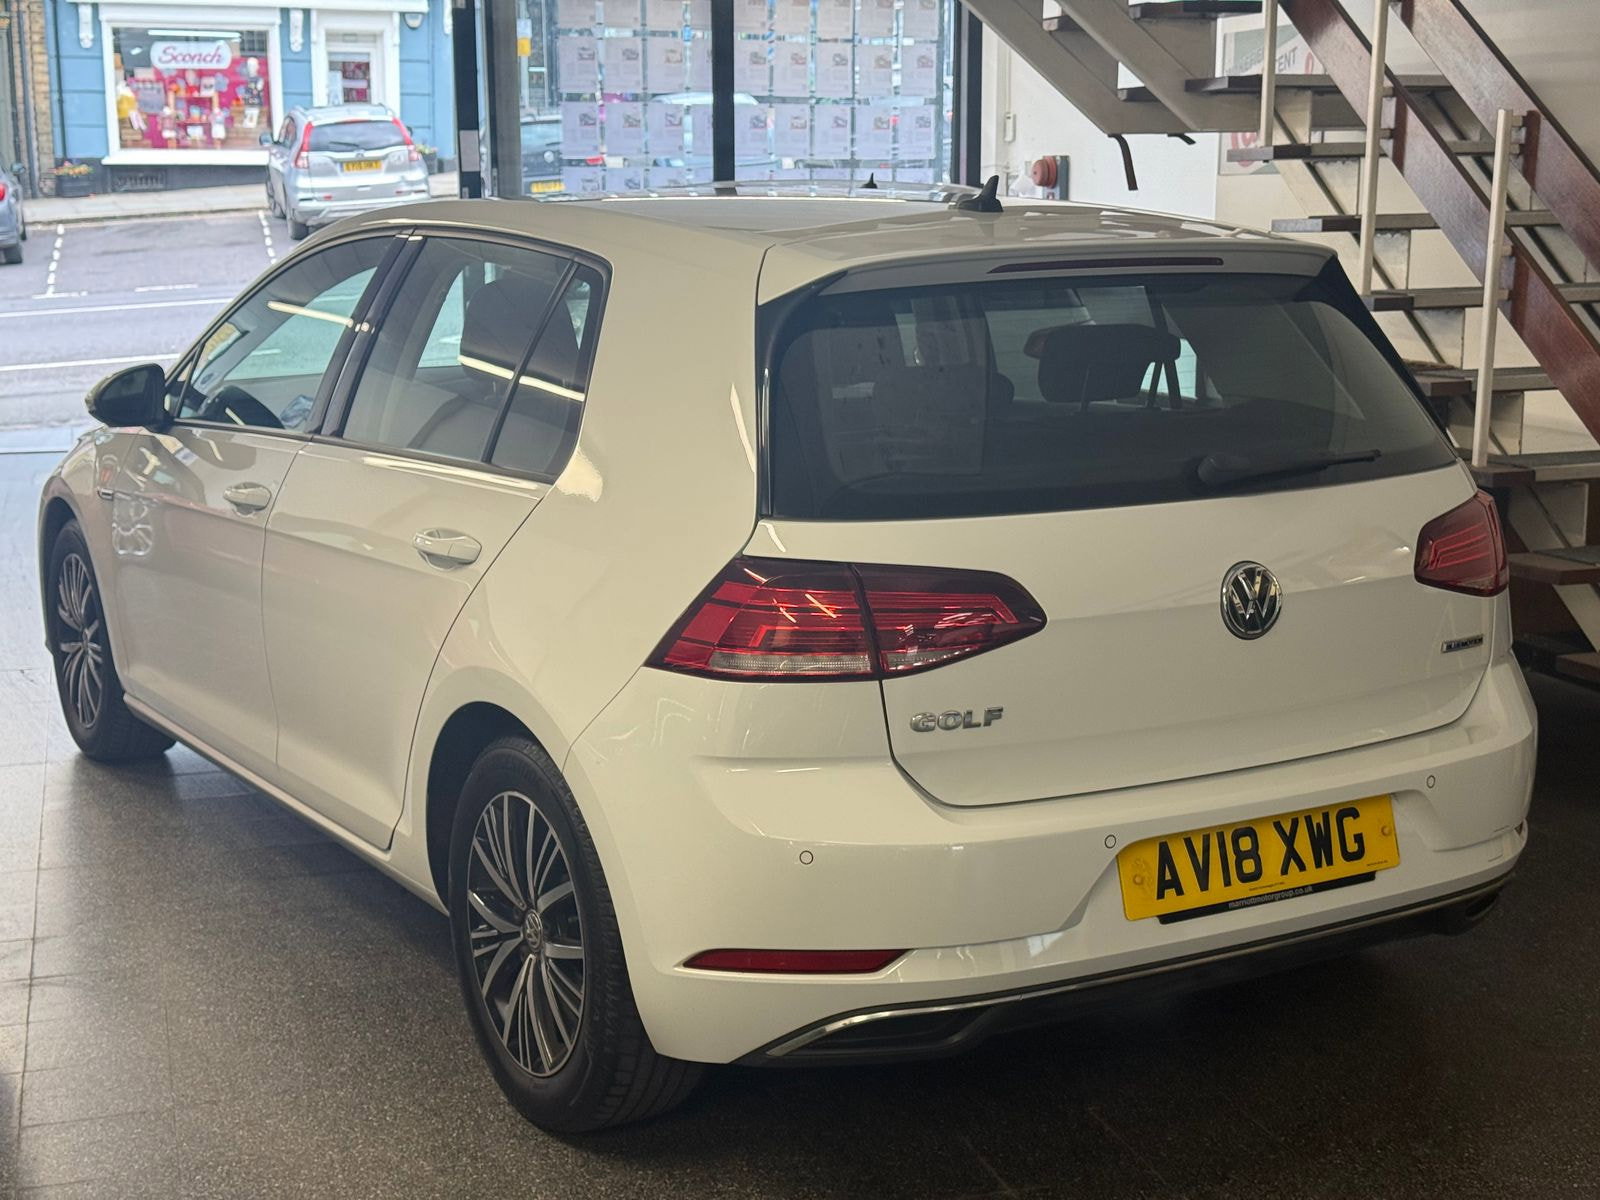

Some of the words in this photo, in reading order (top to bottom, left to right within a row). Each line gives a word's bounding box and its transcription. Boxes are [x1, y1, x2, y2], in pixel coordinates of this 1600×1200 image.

[910, 706, 1004, 732] GOLF
[1156, 826, 1263, 900] AV18
[1273, 807, 1366, 876] XWG
